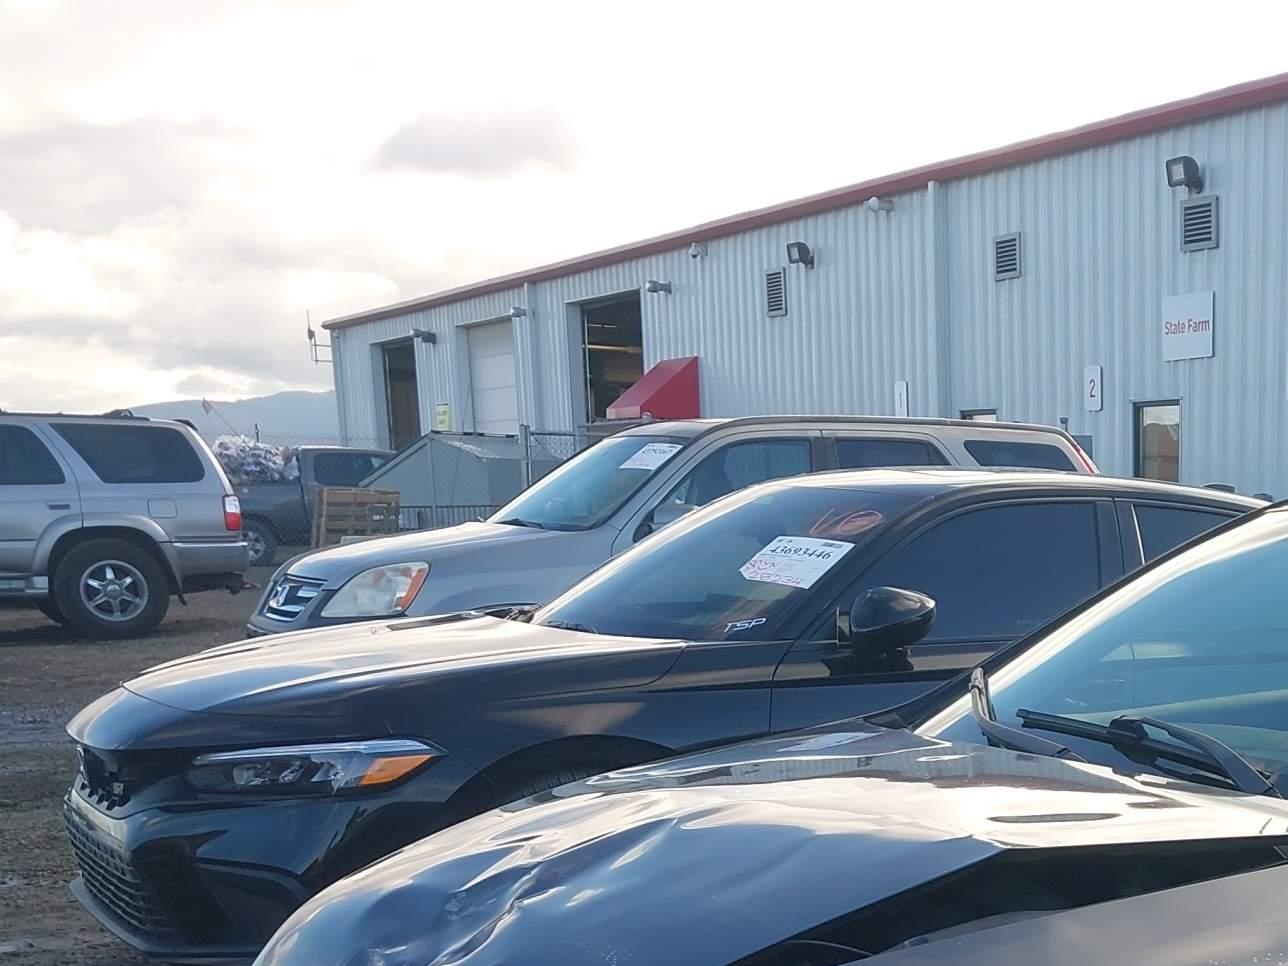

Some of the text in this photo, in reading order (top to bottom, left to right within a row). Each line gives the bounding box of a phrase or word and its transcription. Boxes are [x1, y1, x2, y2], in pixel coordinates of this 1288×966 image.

[1164, 318, 1211, 336] State Farm
[1089, 378, 1096, 398] 2
[768, 544, 832, 561] 43693446
[723, 617, 767, 633] TSP
